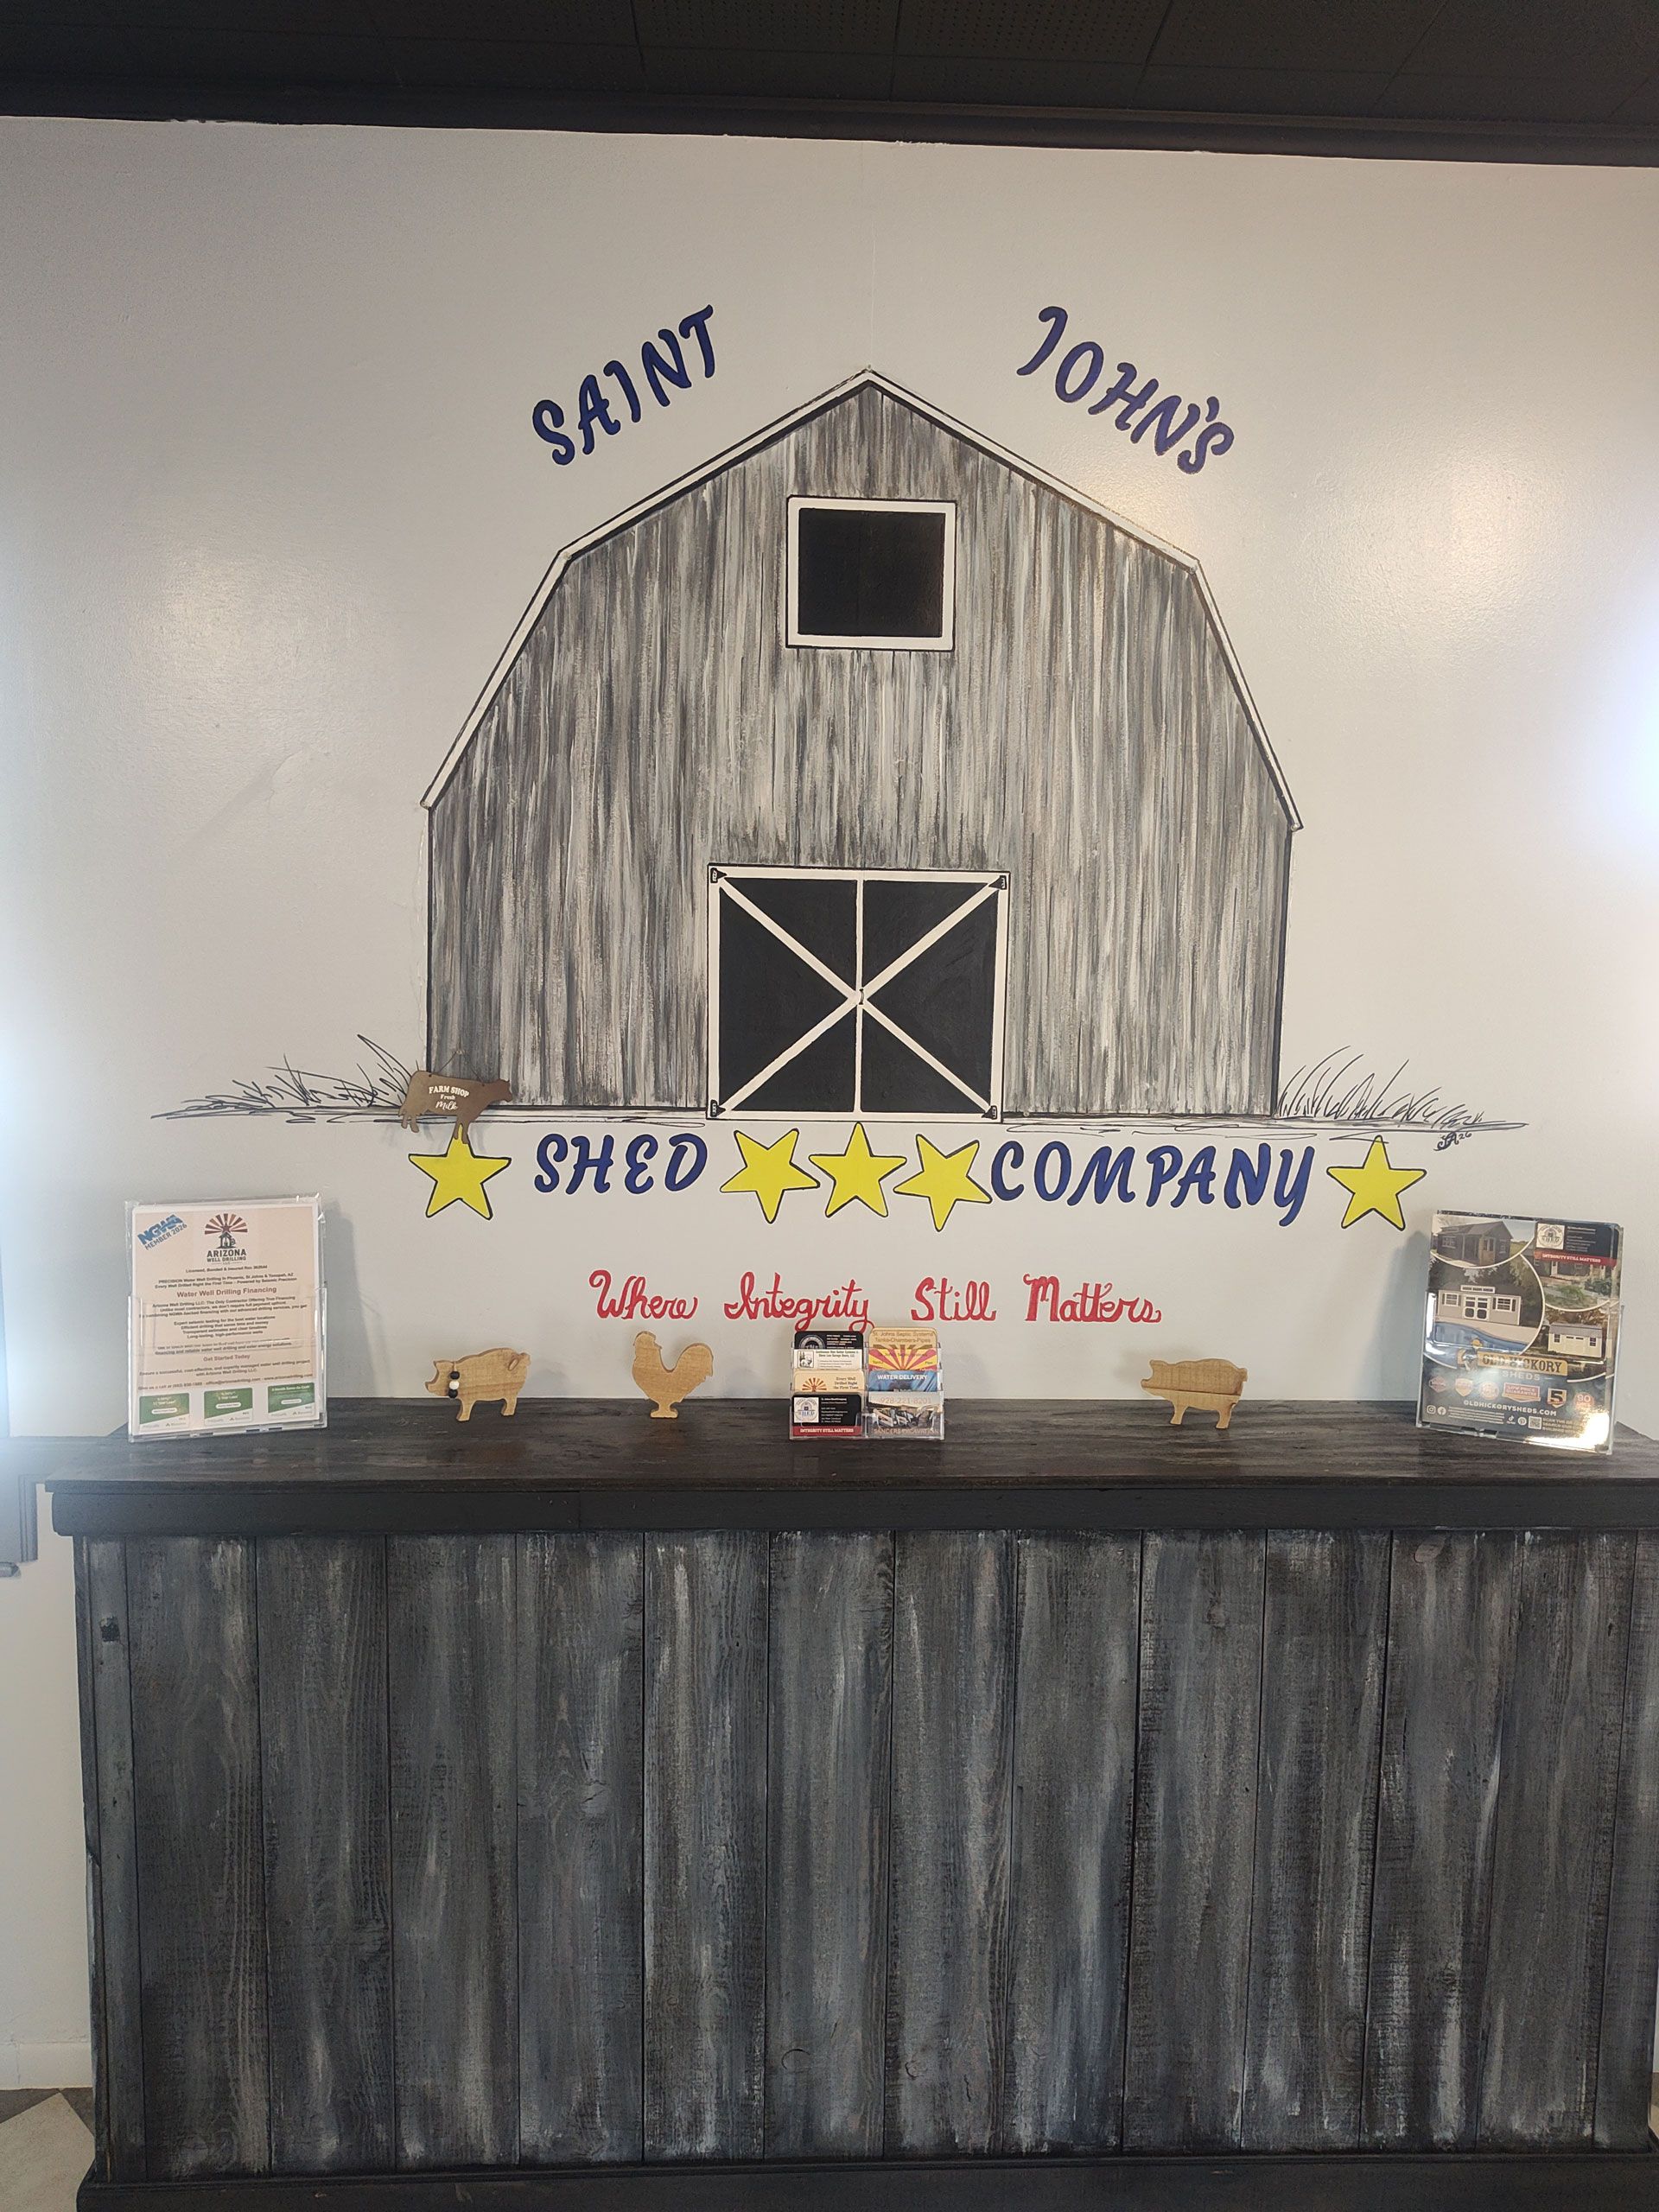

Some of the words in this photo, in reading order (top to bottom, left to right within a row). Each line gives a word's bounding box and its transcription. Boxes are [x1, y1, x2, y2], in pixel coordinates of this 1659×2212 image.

[532, 305, 715, 466] SAINT
[1016, 306, 1236, 476] JOHN'S
[429, 1085, 449, 1095] FARM
[450, 1086, 470, 1097] SHOP
[435, 1101, 458, 1111] Milk
[533, 1133, 708, 1195] SHED
[990, 1139, 1316, 1227] COMPANY
[145, 1233, 172, 1250] MEMBER
[172, 1224, 188, 1236] 2026
[207, 1249, 247, 1258] ARIZONA
[588, 1269, 698, 1320] Where
[723, 1271, 875, 1333] Integrity
[911, 1277, 996, 1323] Still
[1023, 1274, 1163, 1325] Matters
[1509, 1356, 1562, 1373] HCKORY
[1502, 1370, 1540, 1381] SHEDS
[1550, 1390, 1564, 1402] 5
[1463, 1399, 1557, 1416] OLDHICKORYSHEDS.COM
